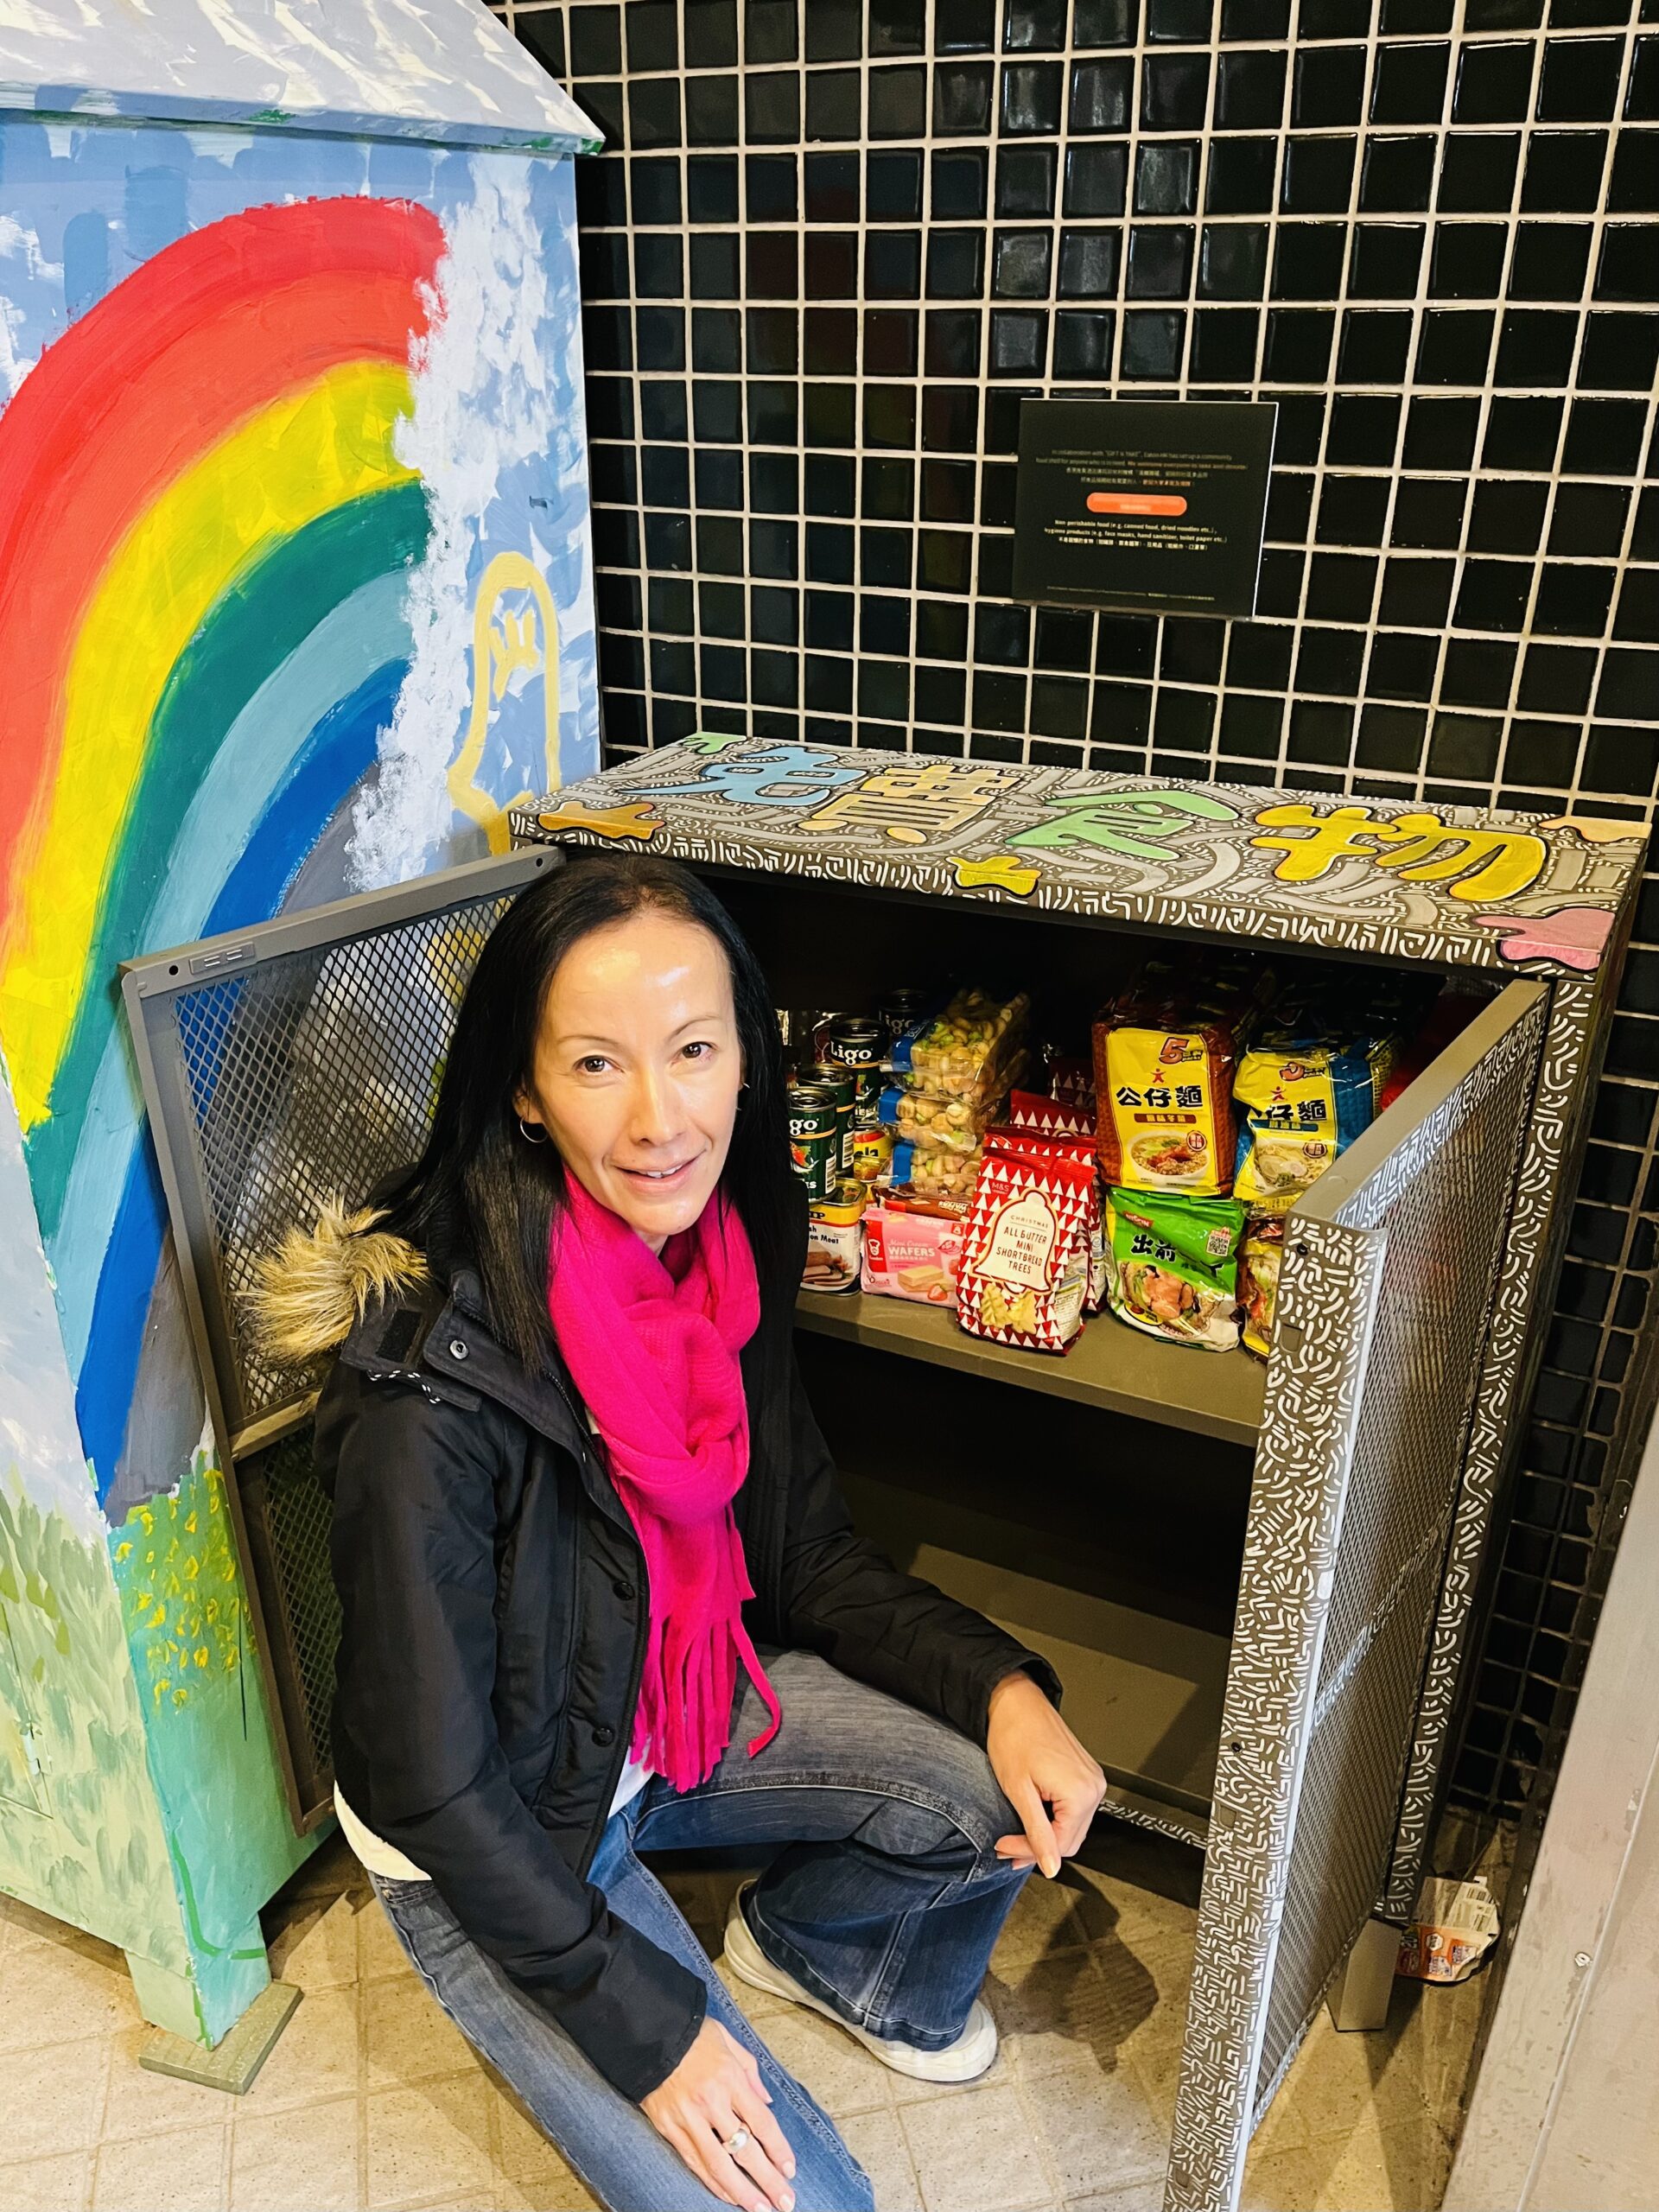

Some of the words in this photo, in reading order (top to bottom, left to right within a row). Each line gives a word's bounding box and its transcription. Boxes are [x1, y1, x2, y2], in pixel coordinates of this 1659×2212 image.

[830, 1040, 873, 1066] Ligo
[1116, 1085, 1204, 1108] 公仔麵
[1253, 1099, 1328, 1122] 仔麵
[789, 1118, 818, 1136] go
[991, 1181, 1010, 1192] M&S
[1010, 1215, 1049, 1229] CHRISTMAS
[821, 1234, 839, 1244] Meat
[1003, 1226, 1019, 1237] ALL
[1020, 1229, 1047, 1244] BUTTER
[888, 1246, 935, 1257] WAFERS
[1016, 1240, 1034, 1252] MINI
[996, 1247, 1043, 1267] SHORTBREAD
[1008, 1261, 1032, 1274] TREES
